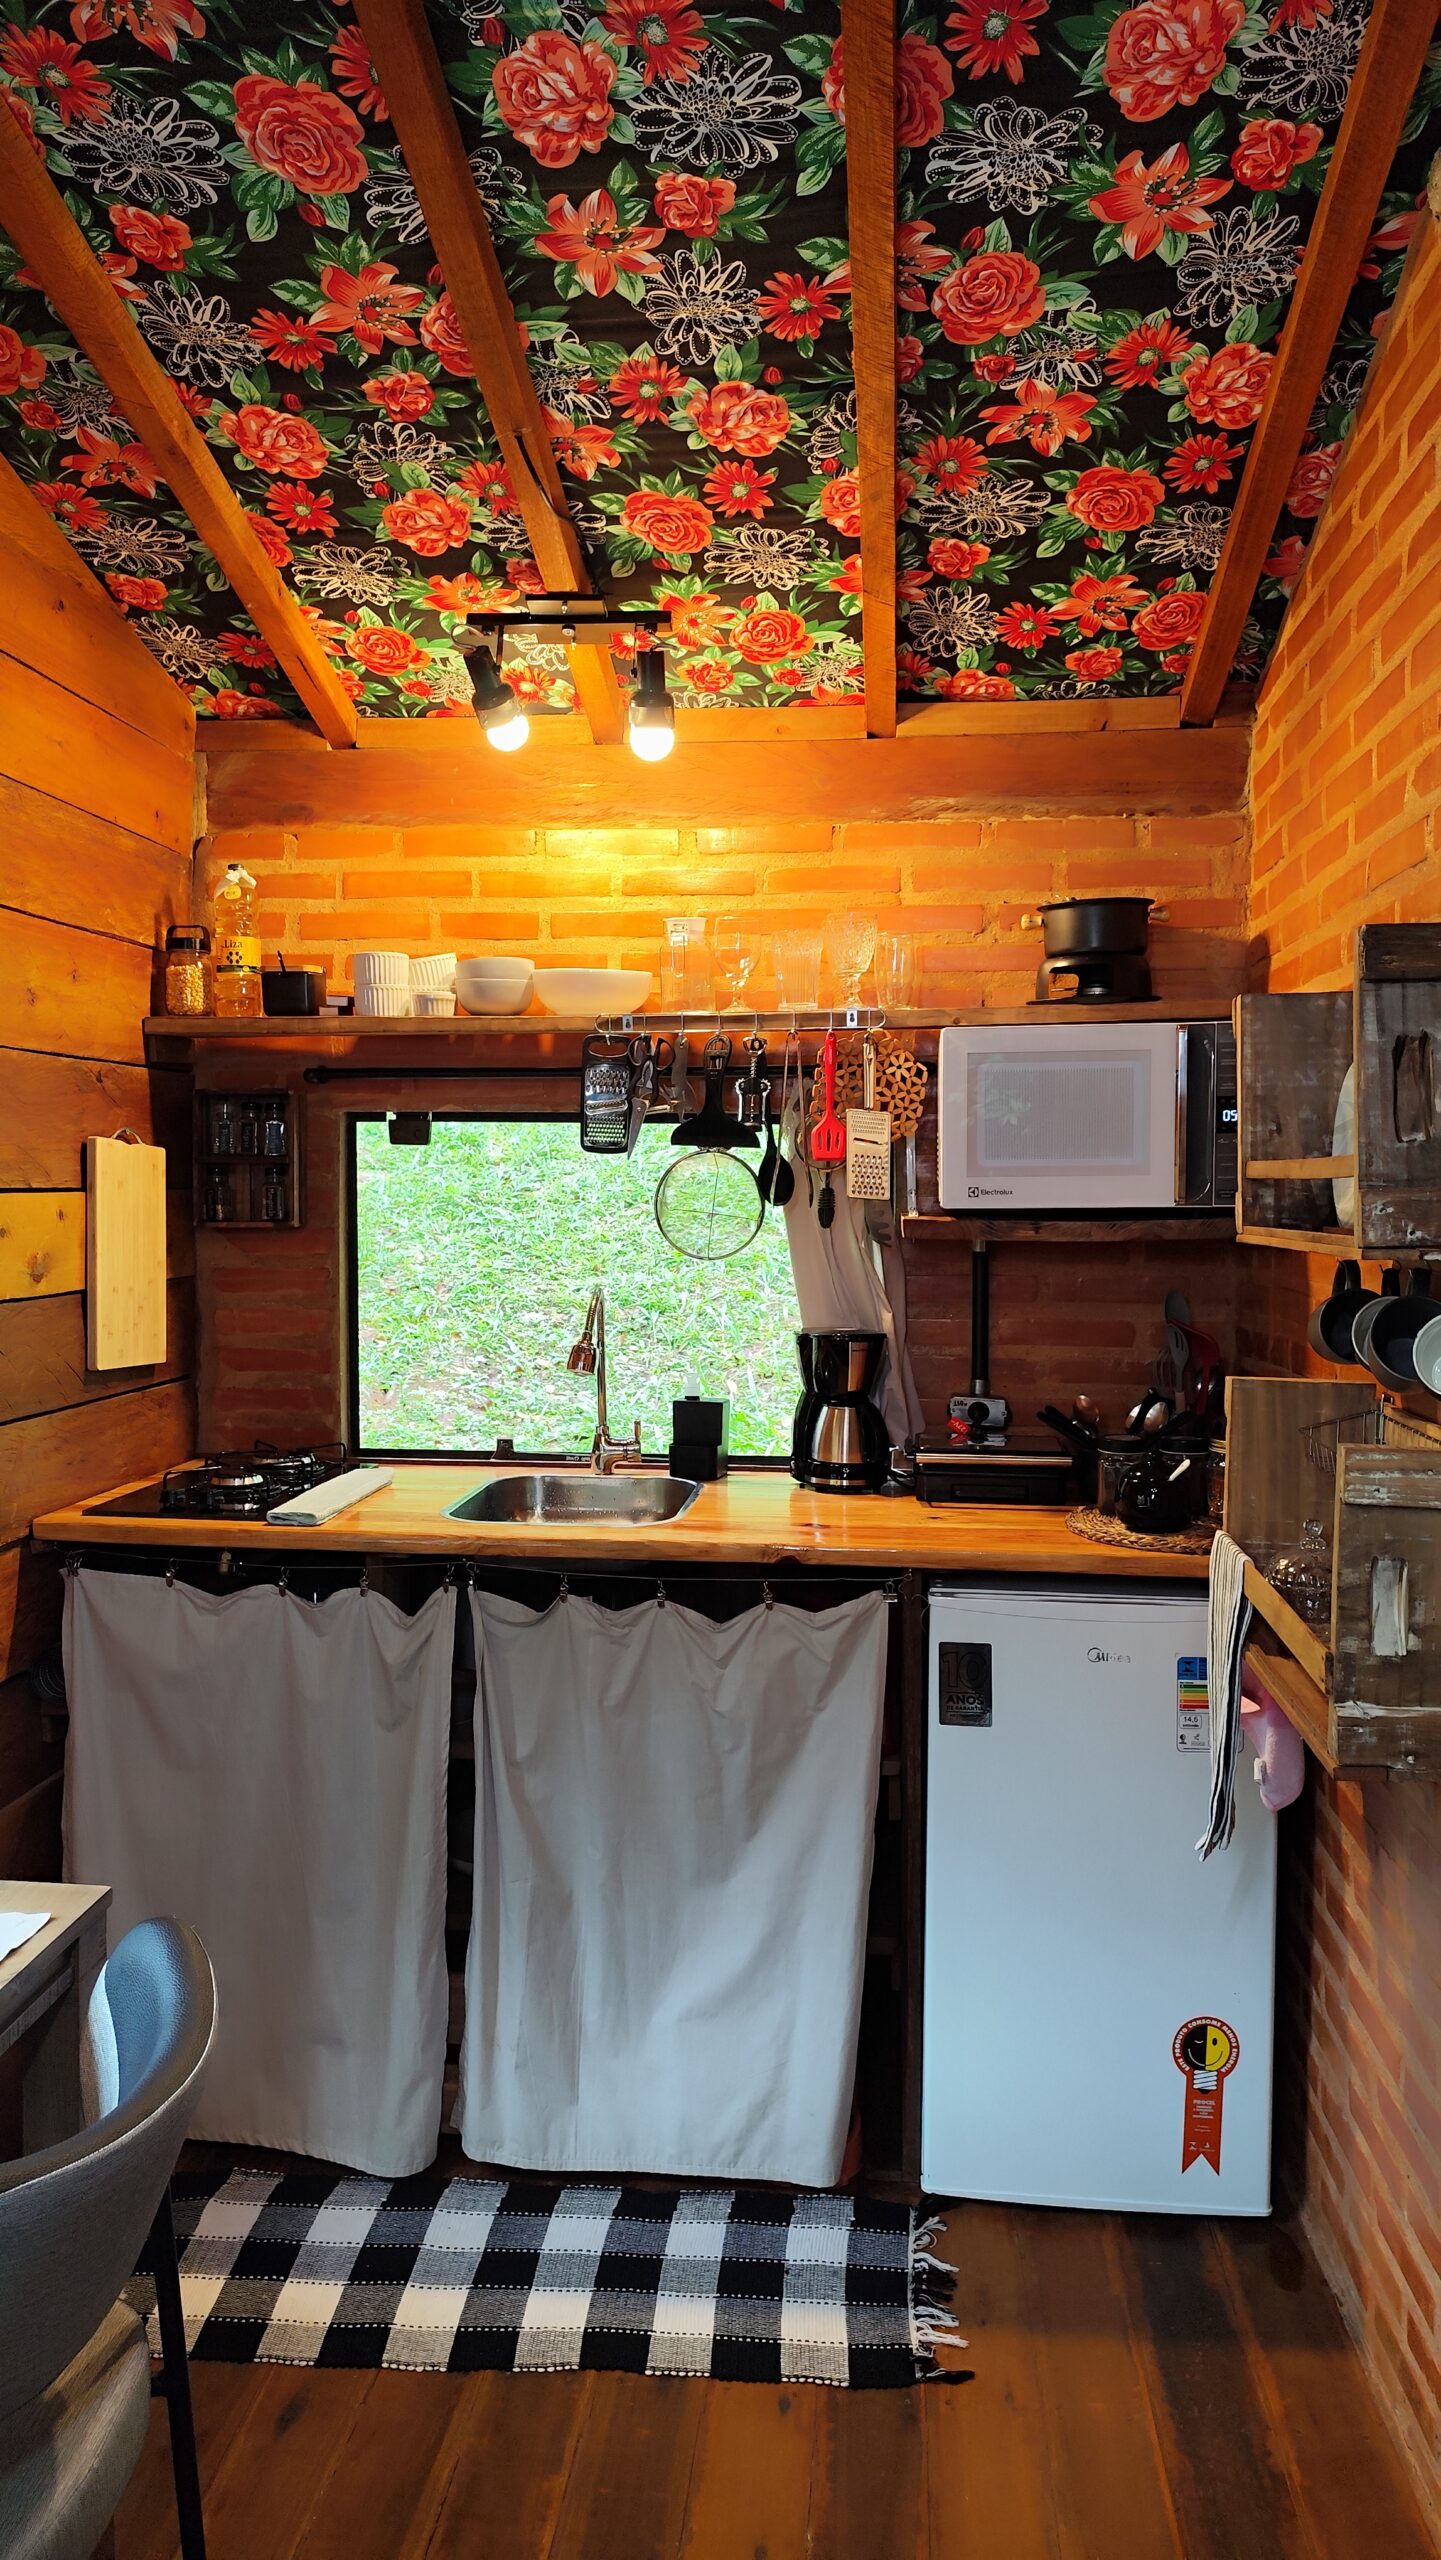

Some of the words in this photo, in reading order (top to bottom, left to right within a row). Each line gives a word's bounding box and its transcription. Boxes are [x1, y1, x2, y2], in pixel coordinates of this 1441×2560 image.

[221, 939, 243, 949] Liza
[1222, 1109, 1238, 1122] 05
[941, 1651, 988, 1690] 10
[946, 1694, 985, 1706] ANOS
[1187, 2019, 1222, 2029] CONSOME
[1174, 2027, 1188, 2057] PRODUTO
[1221, 2025, 1238, 2047] MENOS
[1177, 2058, 1191, 2072] ESTE
